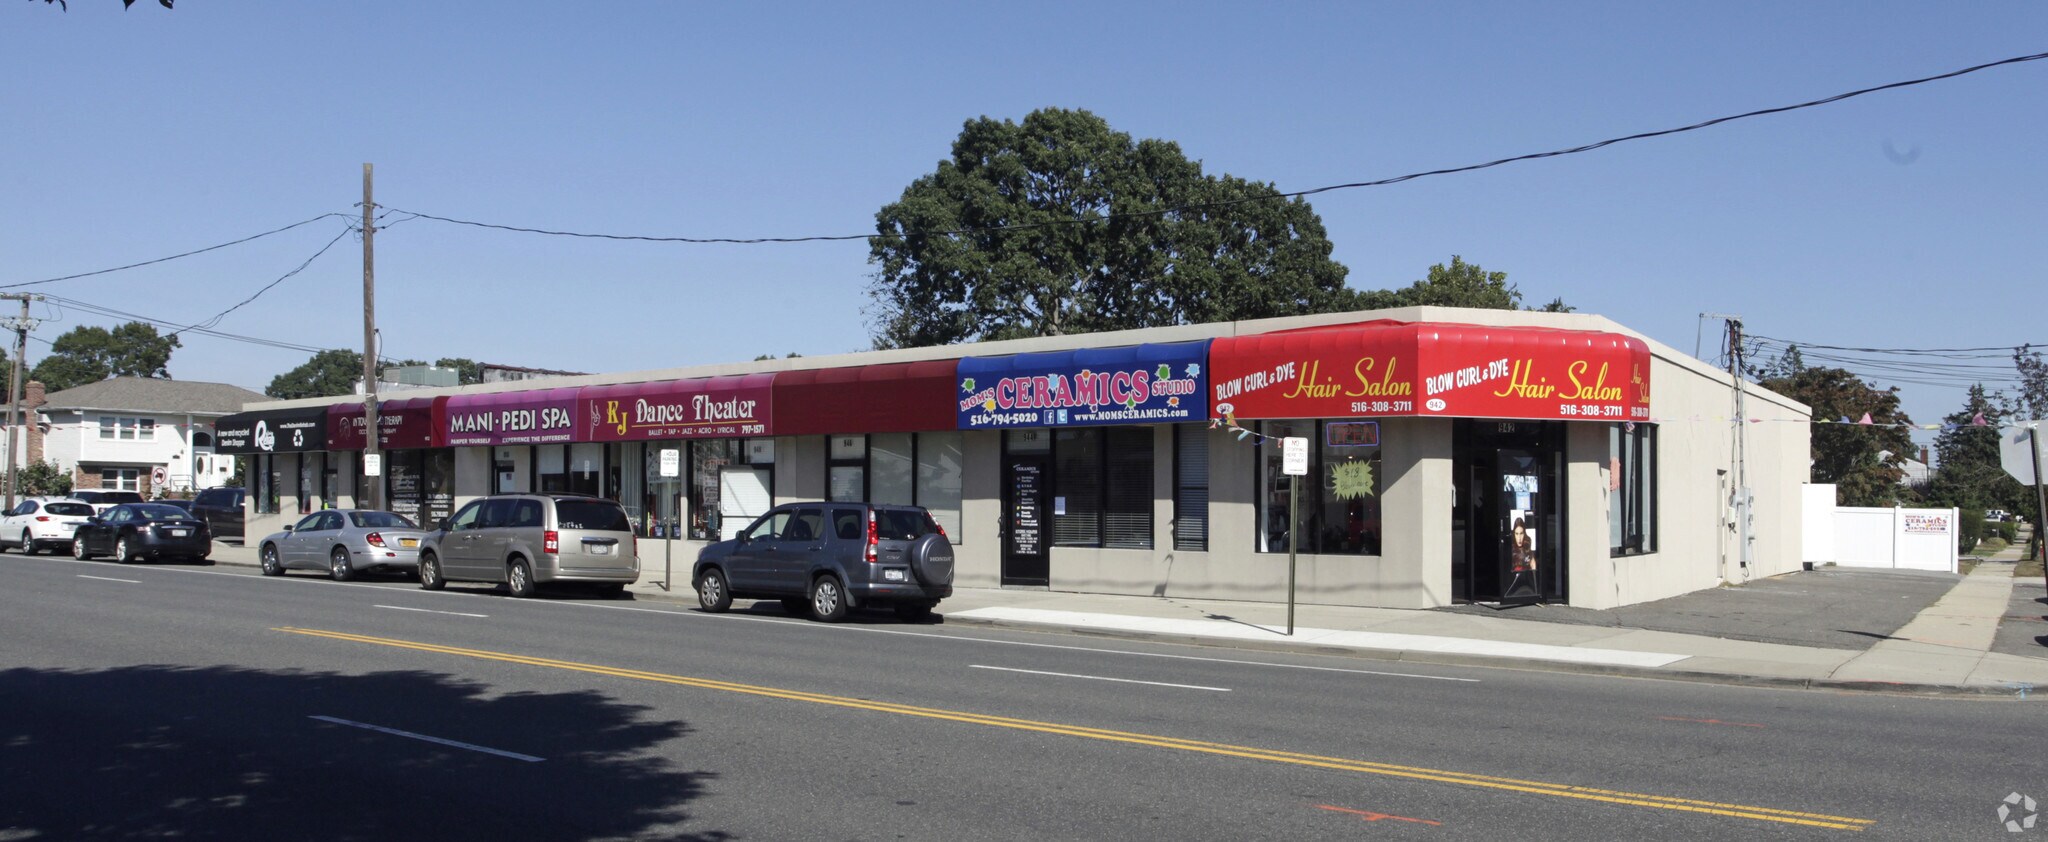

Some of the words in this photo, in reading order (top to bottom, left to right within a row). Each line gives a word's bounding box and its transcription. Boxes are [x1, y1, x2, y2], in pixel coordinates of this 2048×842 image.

[1269, 373, 1275, 384] &
[1276, 361, 1295, 383] DYE
[1283, 359, 1341, 399] Hair
[1345, 356, 1411, 397] Salon
[1456, 366, 1482, 388] CURL
[1482, 369, 1488, 381] &
[1488, 358, 1509, 380] DYE
[1493, 358, 1555, 398] Hair
[960, 387, 996, 412] MOM'S
[996, 370, 1149, 409] CERAMICS
[1152, 379, 1195, 396] STUDIO
[1216, 378, 1241, 401] BLOW
[1244, 370, 1268, 392] CURL
[1426, 372, 1453, 396] BLOW
[1558, 360, 1622, 401] Salon
[636, 398, 684, 426] Dance
[692, 394, 756, 424] Theater
[1074, 408, 1188, 421] www.MOMSCERAMICS.com
[1351, 401, 1412, 412] 516-308-3711
[1429, 401, 1443, 409] 942
[1560, 404, 1623, 416] 516-308-3711
[541, 407, 571, 430] SPA
[741, 425, 765, 434] 797-1571
[970, 412, 1038, 426] 516-794-5020
[717, 426, 736, 434] LYRICAL
